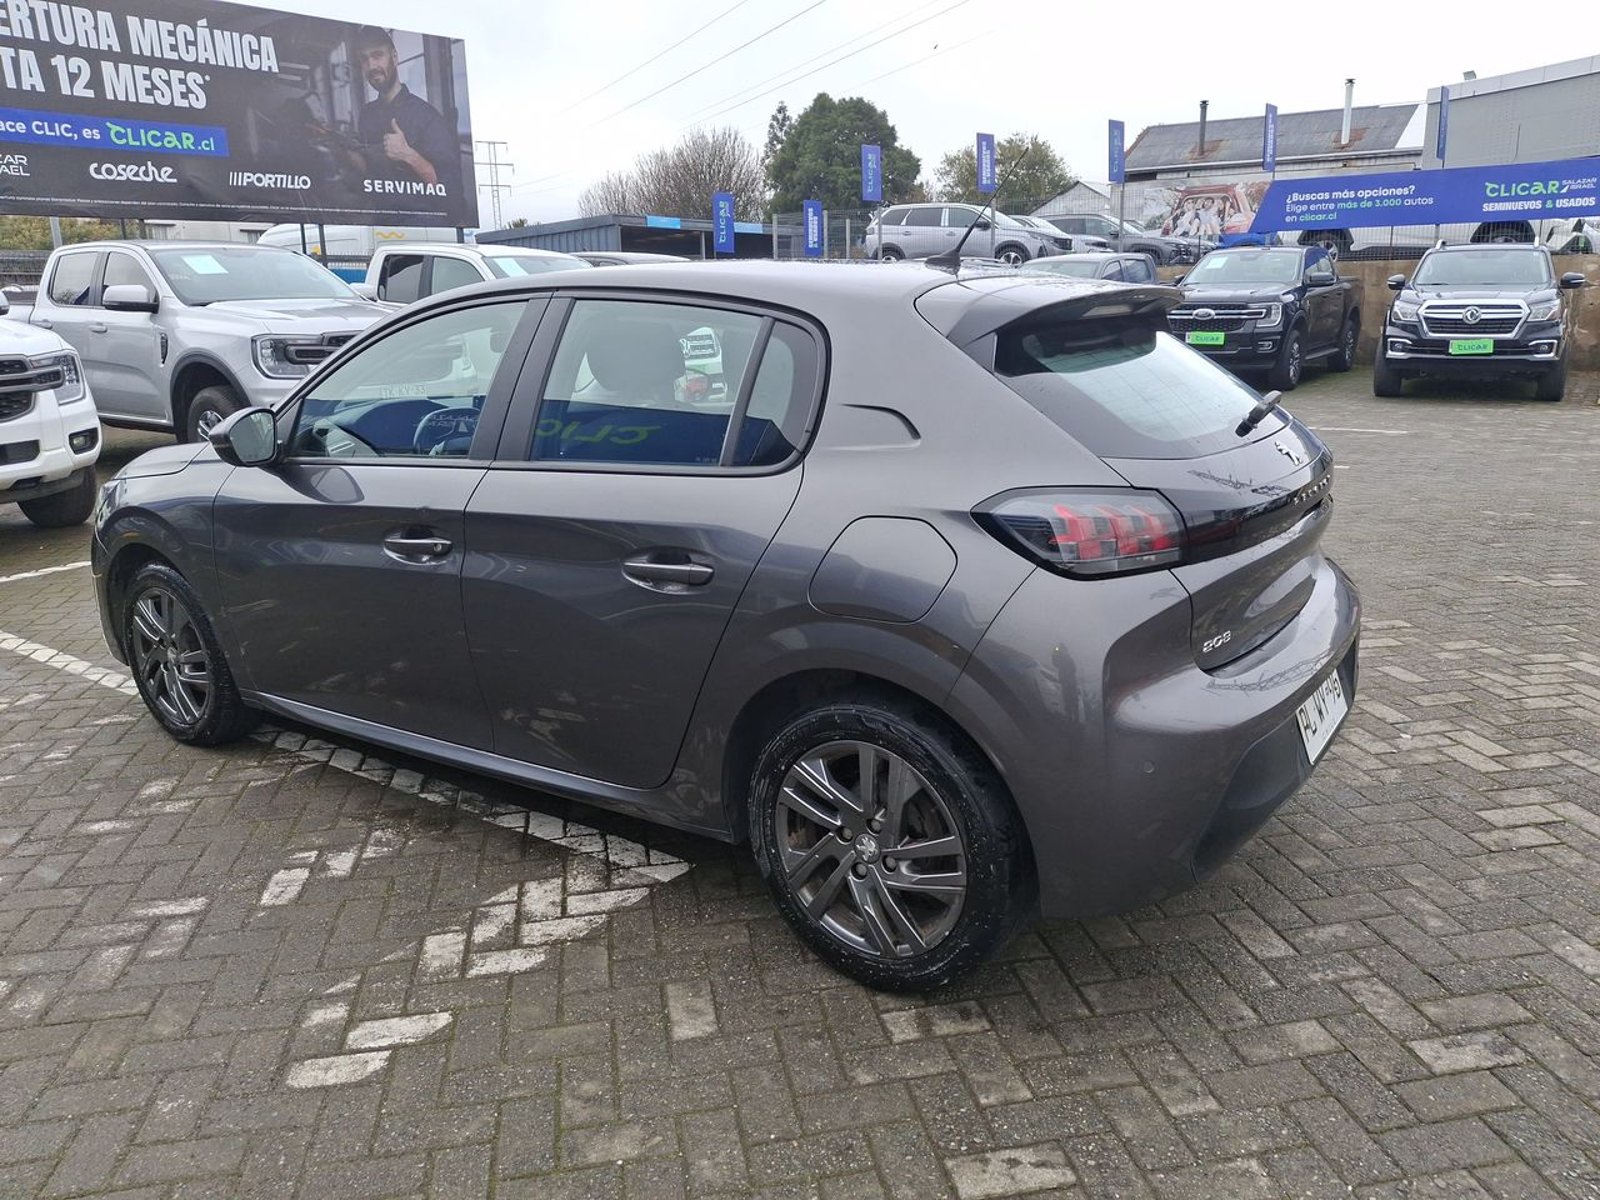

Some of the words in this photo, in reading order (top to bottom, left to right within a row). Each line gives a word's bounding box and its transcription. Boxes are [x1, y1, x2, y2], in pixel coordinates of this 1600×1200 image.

[126, 17, 280, 73] MECÁNICA
[0, 46, 46, 93] TA
[51, 54, 95, 98] 12
[32, 121, 78, 140] CLIC,
[82, 127, 100, 139] es
[0, 154, 28, 165] AR
[363, 179, 447, 196] SERVIMAQ
[1286, 193, 1330, 203] ¿Buscas
[1332, 189, 1355, 199] más
[1357, 185, 1416, 199] opciones?
[1286, 203, 1308, 213] Elige
[1310, 201, 1335, 211] entre
[1337, 200, 1359, 209] más
[1360, 198, 1373, 208] de
[1375, 198, 1402, 207] 3.000
[1404, 196, 1434, 206] autos
[1482, 200, 1543, 212] SEMINUEVOS
[1545, 199, 1554, 209] &
[1555, 197, 1596, 208] USADOS
[1285, 214, 1298, 222] en
[1299, 211, 1337, 221] clicar.cl
